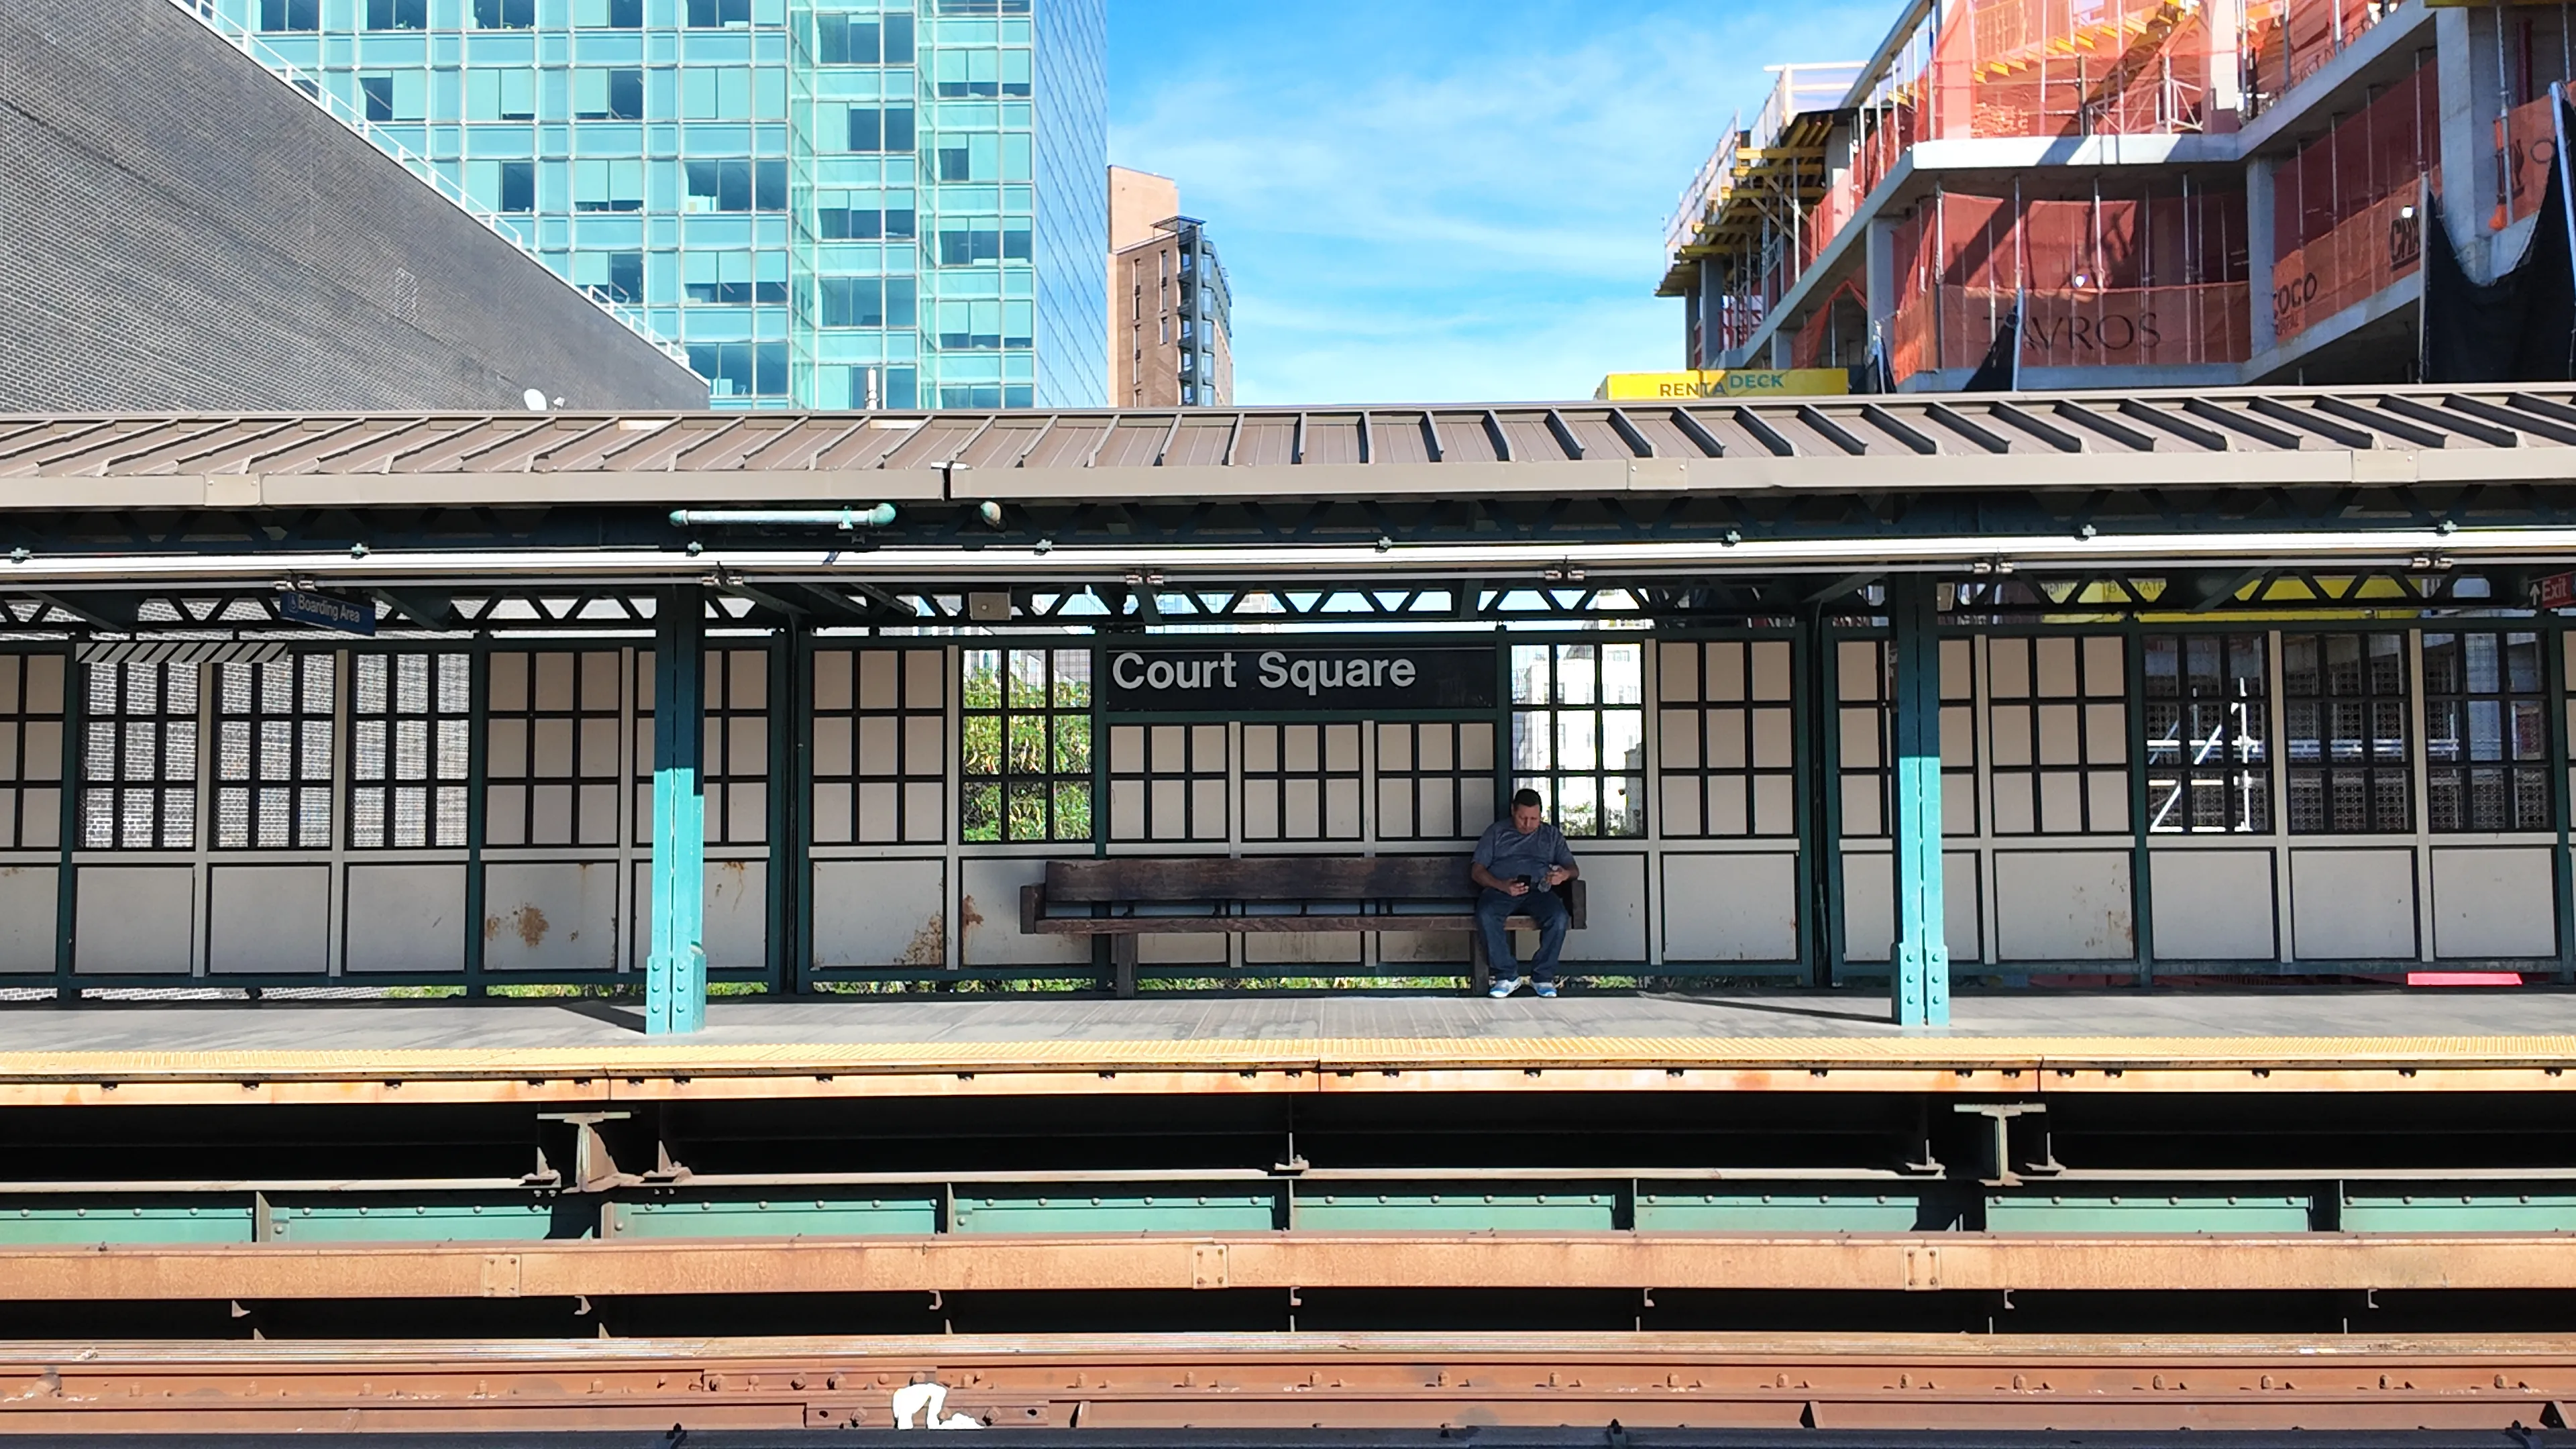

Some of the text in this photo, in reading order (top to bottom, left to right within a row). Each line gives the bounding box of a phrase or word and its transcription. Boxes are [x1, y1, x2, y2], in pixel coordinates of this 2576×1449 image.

[2542, 578, 2567, 602] Exit
[299, 594, 360, 623] Boarding Area
[1112, 650, 1417, 696] Court Square
